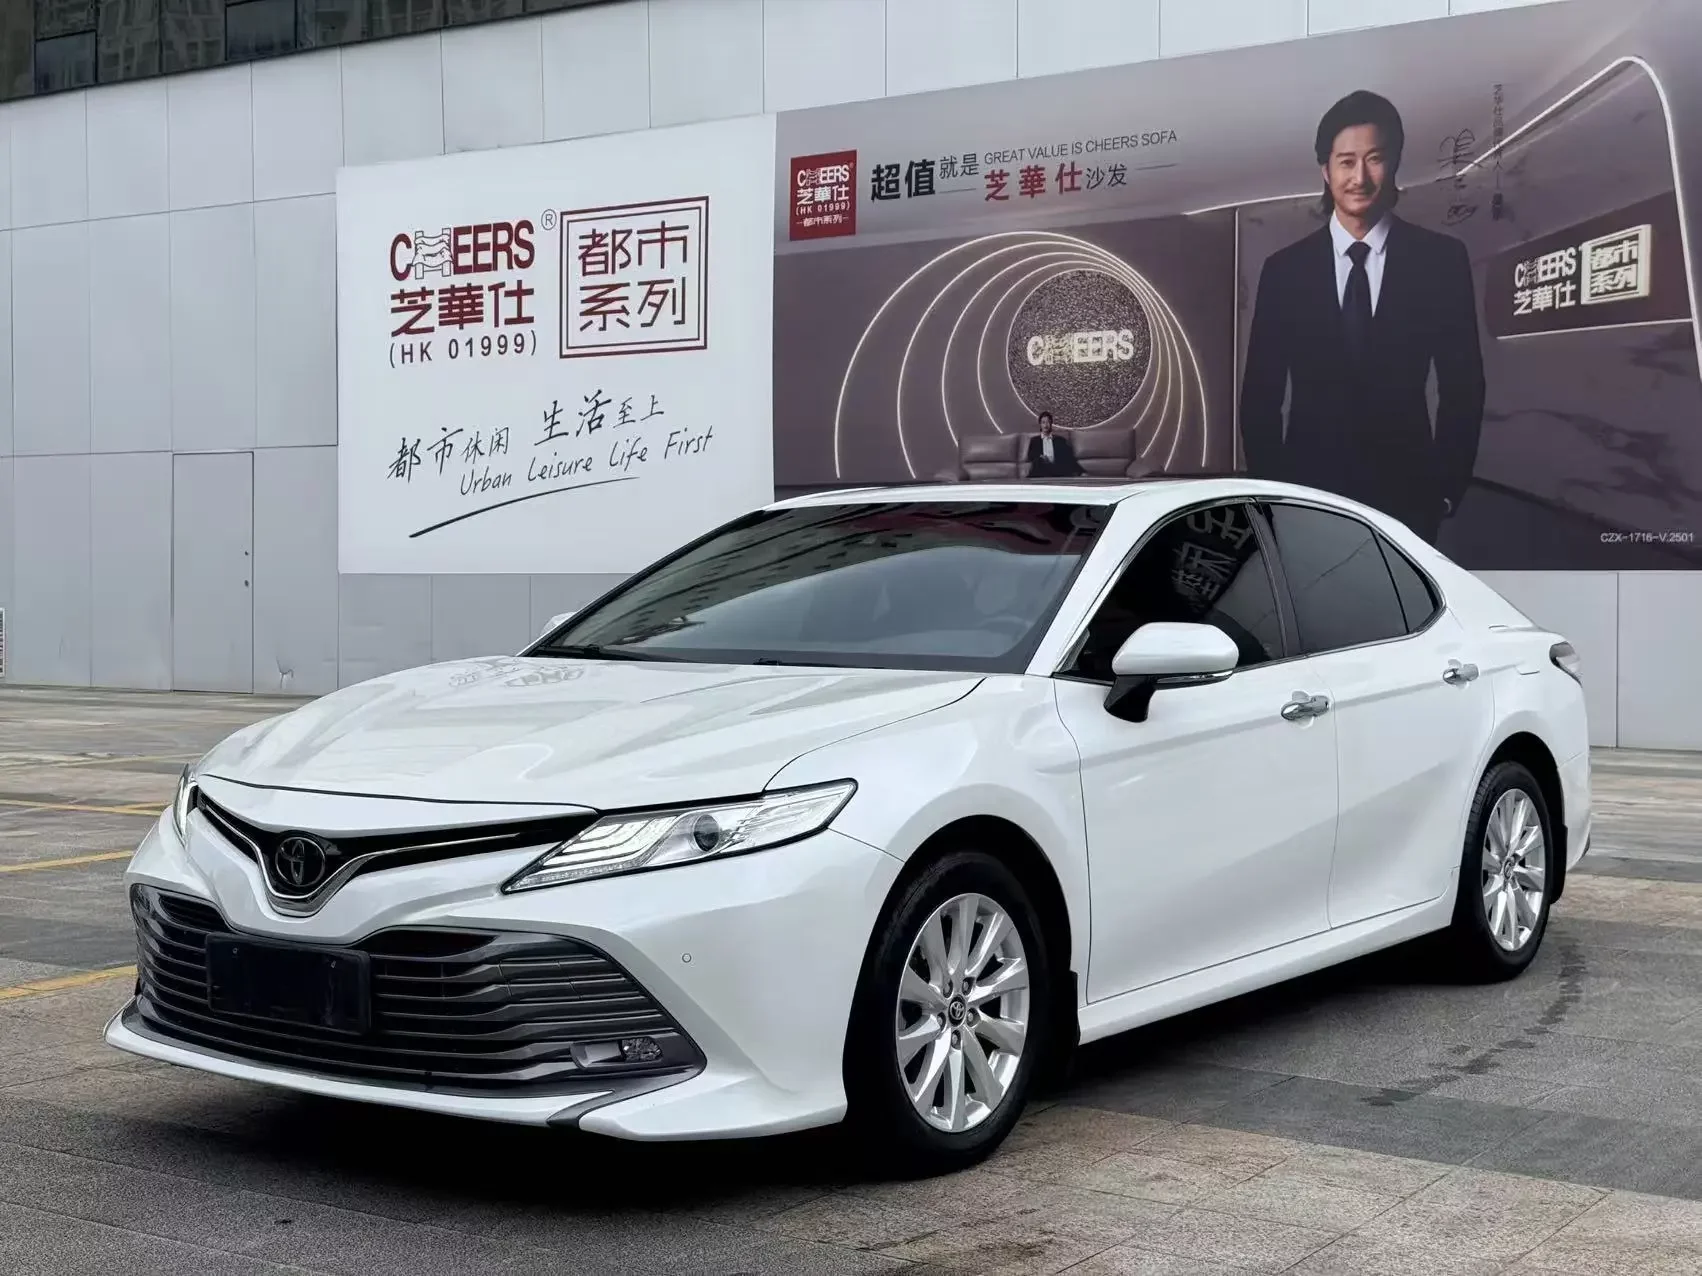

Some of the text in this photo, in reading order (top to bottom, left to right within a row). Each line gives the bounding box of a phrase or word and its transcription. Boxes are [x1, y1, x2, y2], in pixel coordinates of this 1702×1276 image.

[984, 130, 1177, 165] GREAT VALUE IS CHEERS SOFA
[797, 184, 850, 206] 芝華仕
[578, 220, 690, 277] 都市
[391, 279, 535, 337] 芝華仕
[579, 276, 686, 332] 系列
[1513, 280, 1577, 315] 芝華仕
[389, 329, 537, 369] (HK 01999)
[533, 389, 664, 446] 生活至上
[460, 425, 714, 496] Urban Leisure Life First
[1600, 532, 1695, 543] CZX-1716-V.2501
